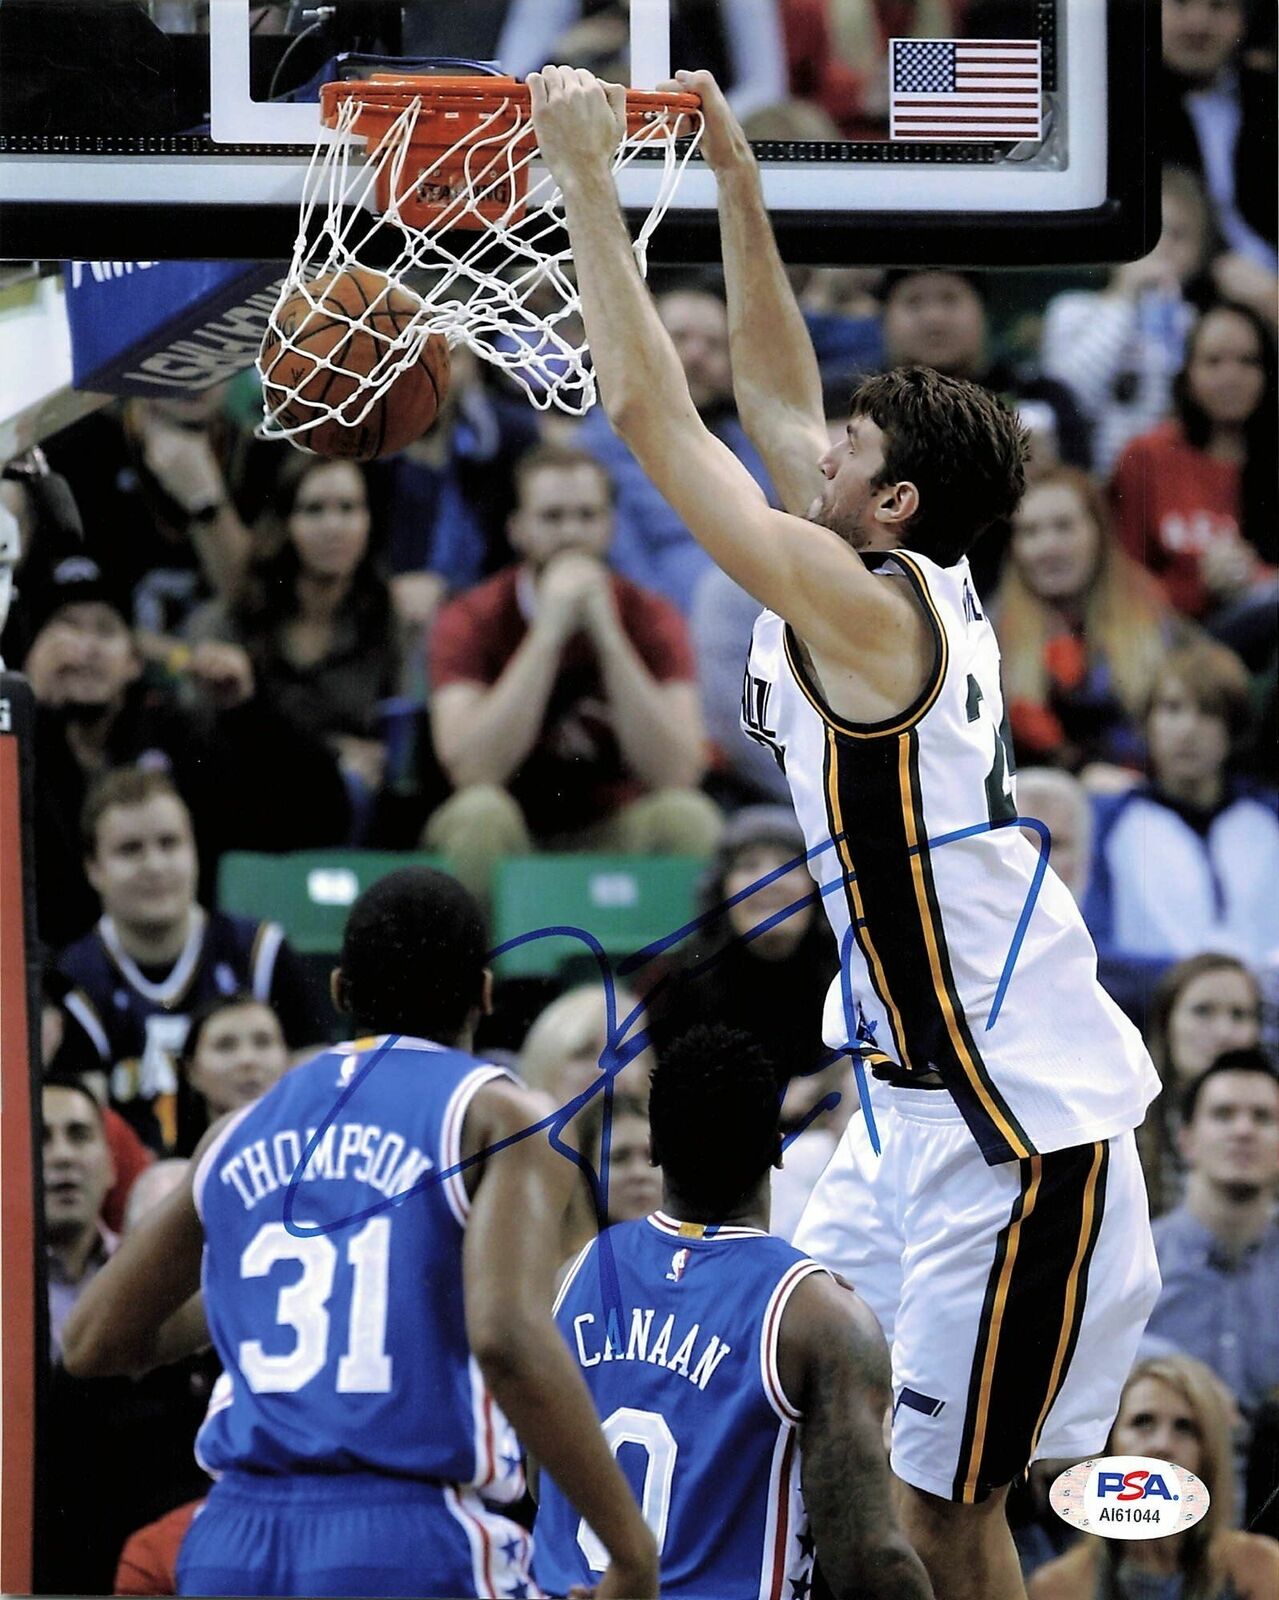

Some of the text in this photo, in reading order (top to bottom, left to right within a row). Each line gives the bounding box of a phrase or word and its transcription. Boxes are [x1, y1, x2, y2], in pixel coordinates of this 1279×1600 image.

[220, 1123, 433, 1210] THOMPSON
[239, 1216, 393, 1394] 31
[574, 1308, 730, 1391] CANAAN
